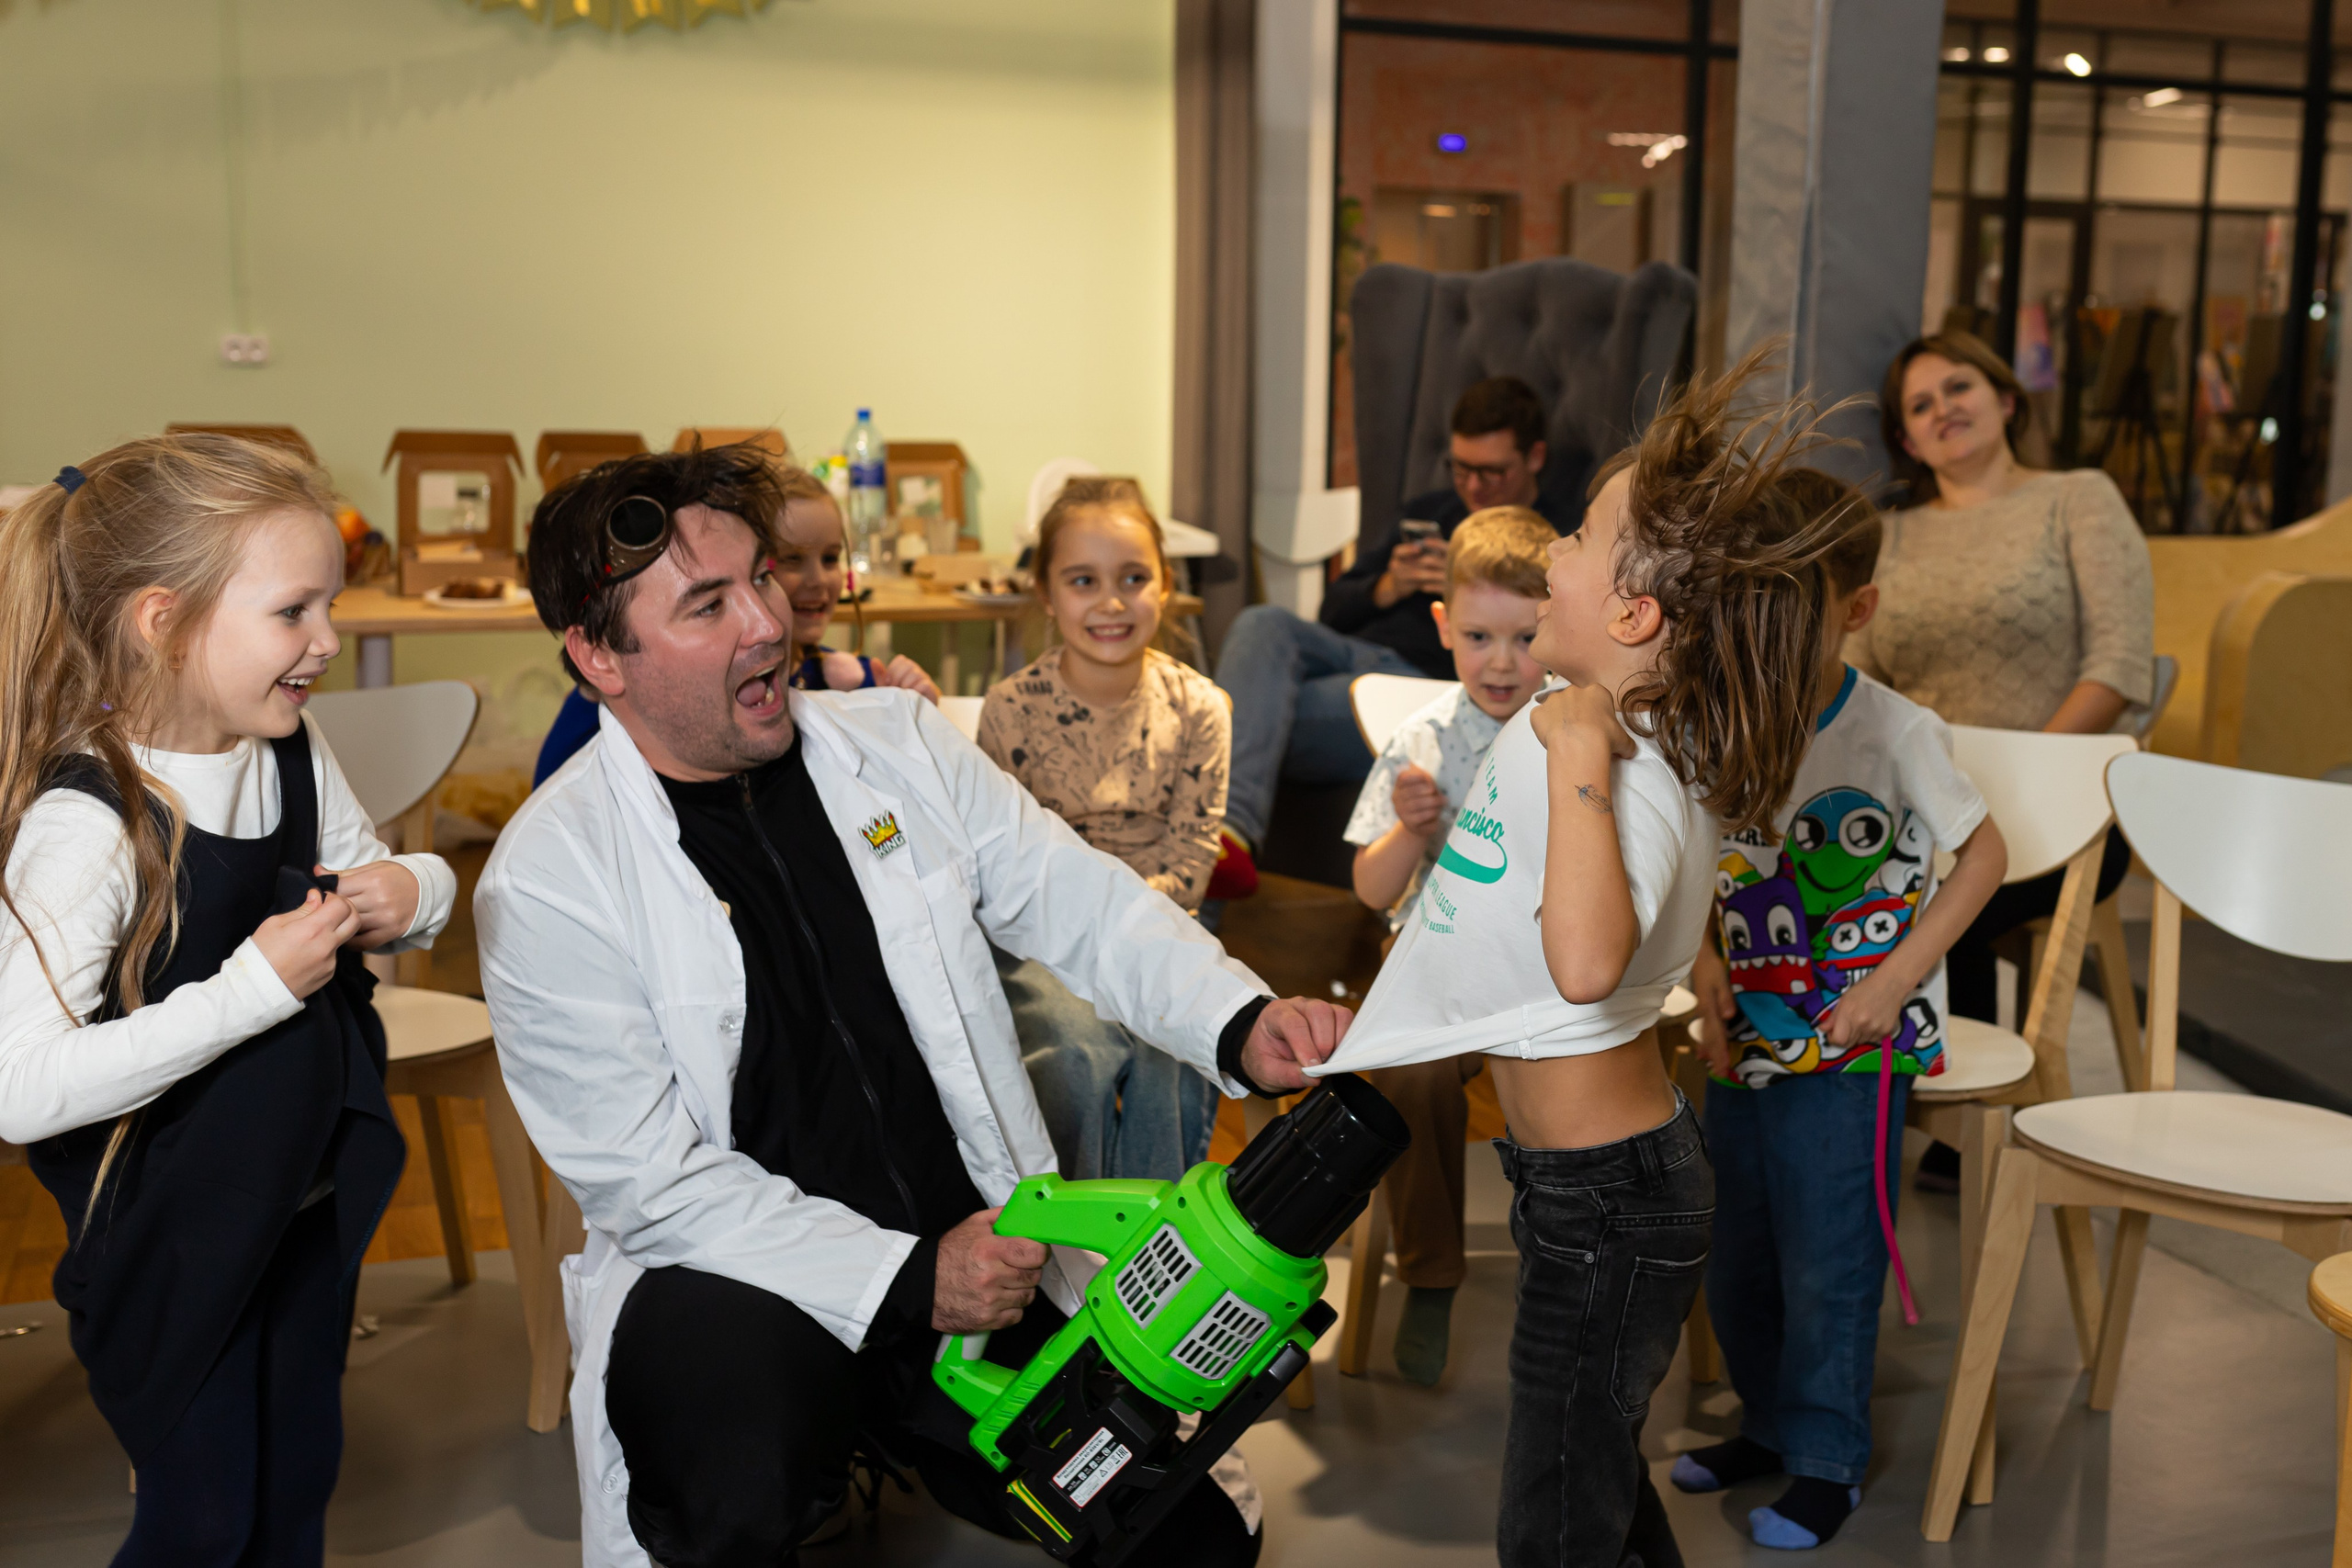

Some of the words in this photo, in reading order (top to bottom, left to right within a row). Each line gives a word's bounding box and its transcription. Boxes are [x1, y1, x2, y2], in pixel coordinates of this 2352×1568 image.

[1456, 807, 1505, 843] ancisco
[876, 834, 905, 858] KING
[1429, 920, 1455, 934] BASEBALL
